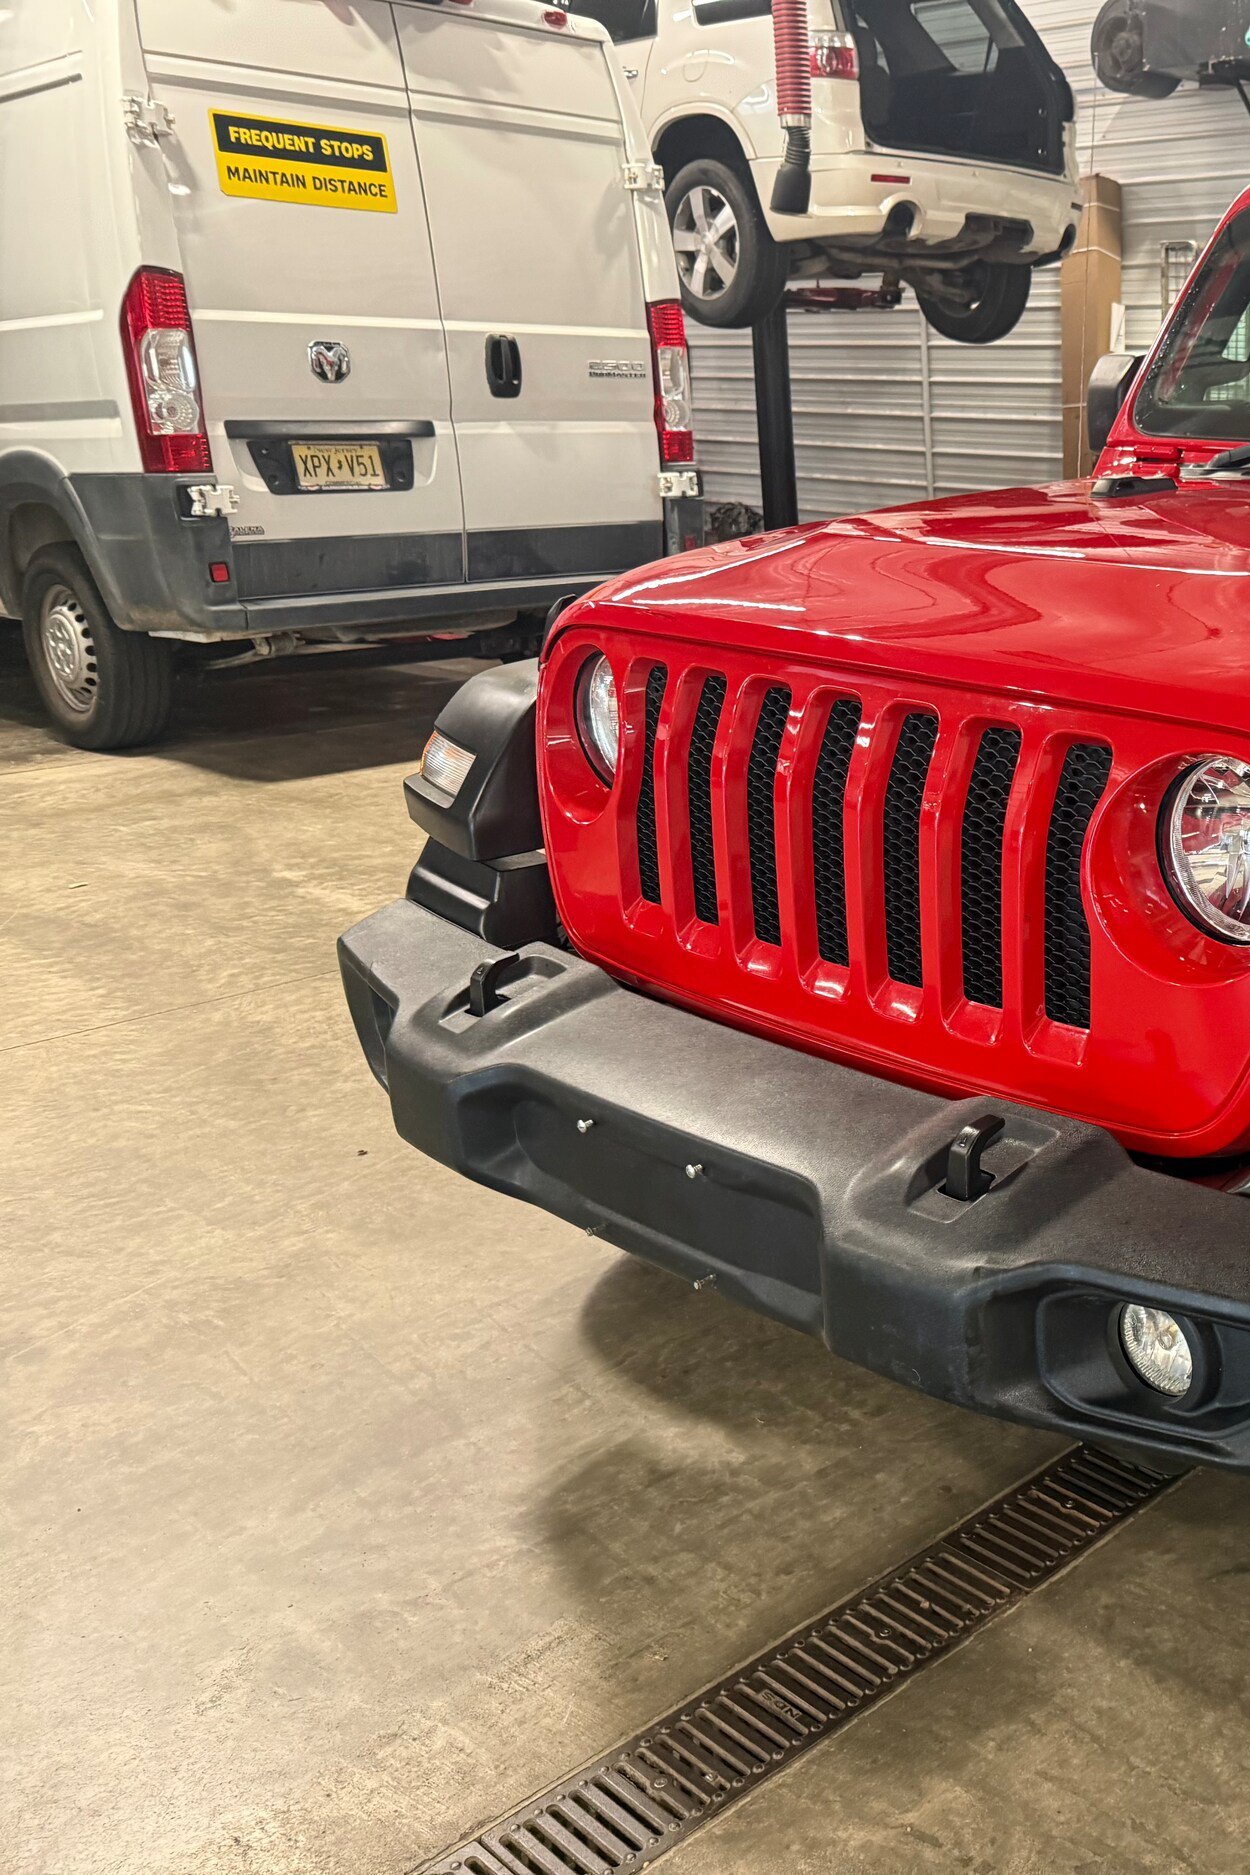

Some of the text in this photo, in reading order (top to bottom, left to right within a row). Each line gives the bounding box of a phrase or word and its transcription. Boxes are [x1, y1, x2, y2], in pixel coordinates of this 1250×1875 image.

[228, 126, 374, 161] FREQUENT STOPS
[226, 165, 388, 198] MAINTAIN DISTANCE
[298, 454, 380, 478] XPX V51
[761, 1691, 800, 1719] NDS
